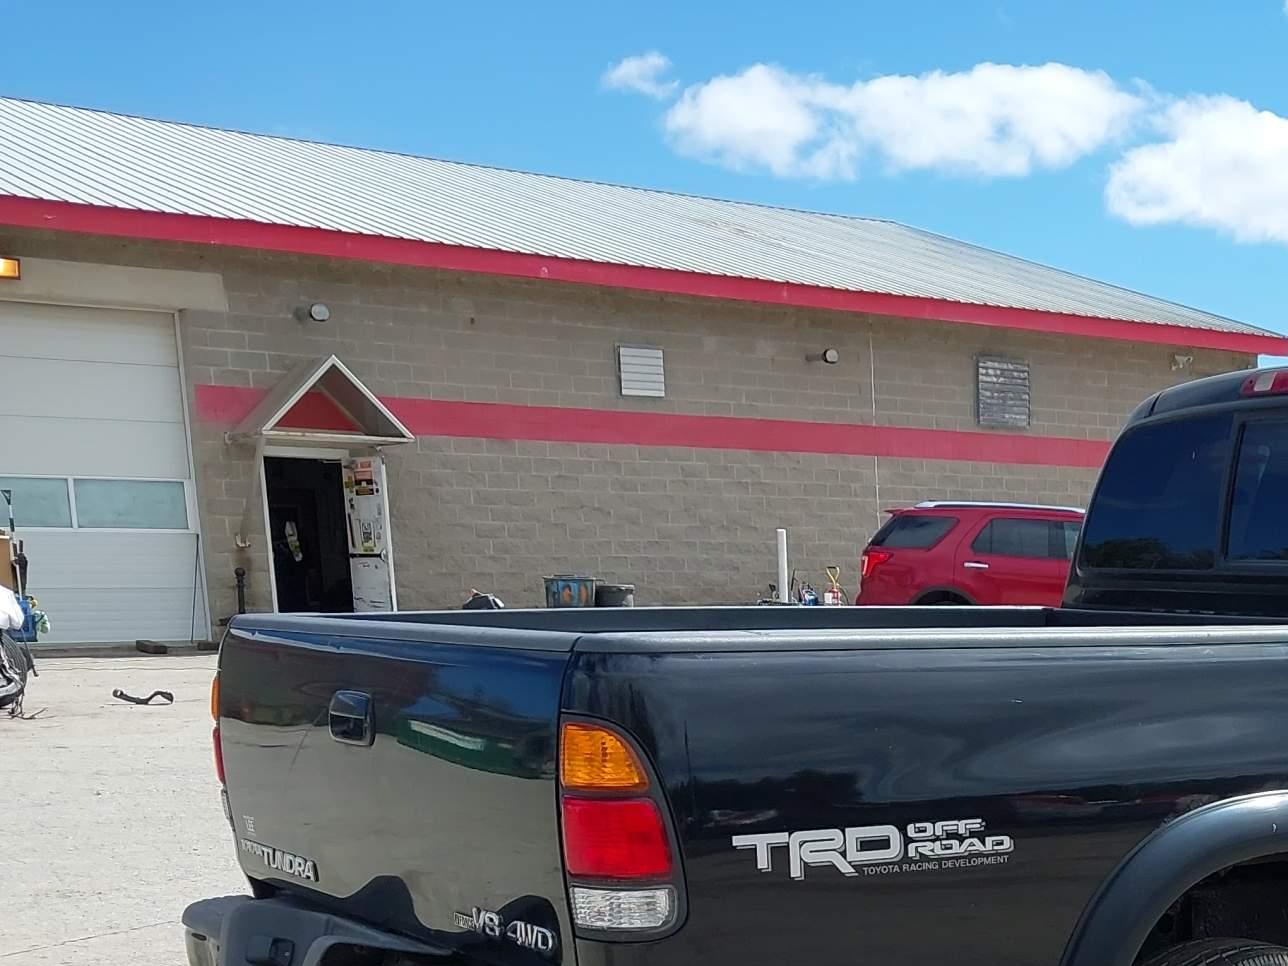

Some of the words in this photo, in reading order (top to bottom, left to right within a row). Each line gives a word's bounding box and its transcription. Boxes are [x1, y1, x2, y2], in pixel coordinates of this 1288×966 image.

[906, 818, 985, 839] OFF
[731, 824, 905, 881] TRD
[907, 834, 1015, 860] ROAD
[261, 846, 316, 882] TUNDRA
[862, 865, 900, 876] TOYOTA
[902, 860, 939, 872] RACING
[941, 854, 1009, 869] DEVELOPMENT
[472, 907, 500, 937] V8
[505, 919, 553, 952] 4WD
